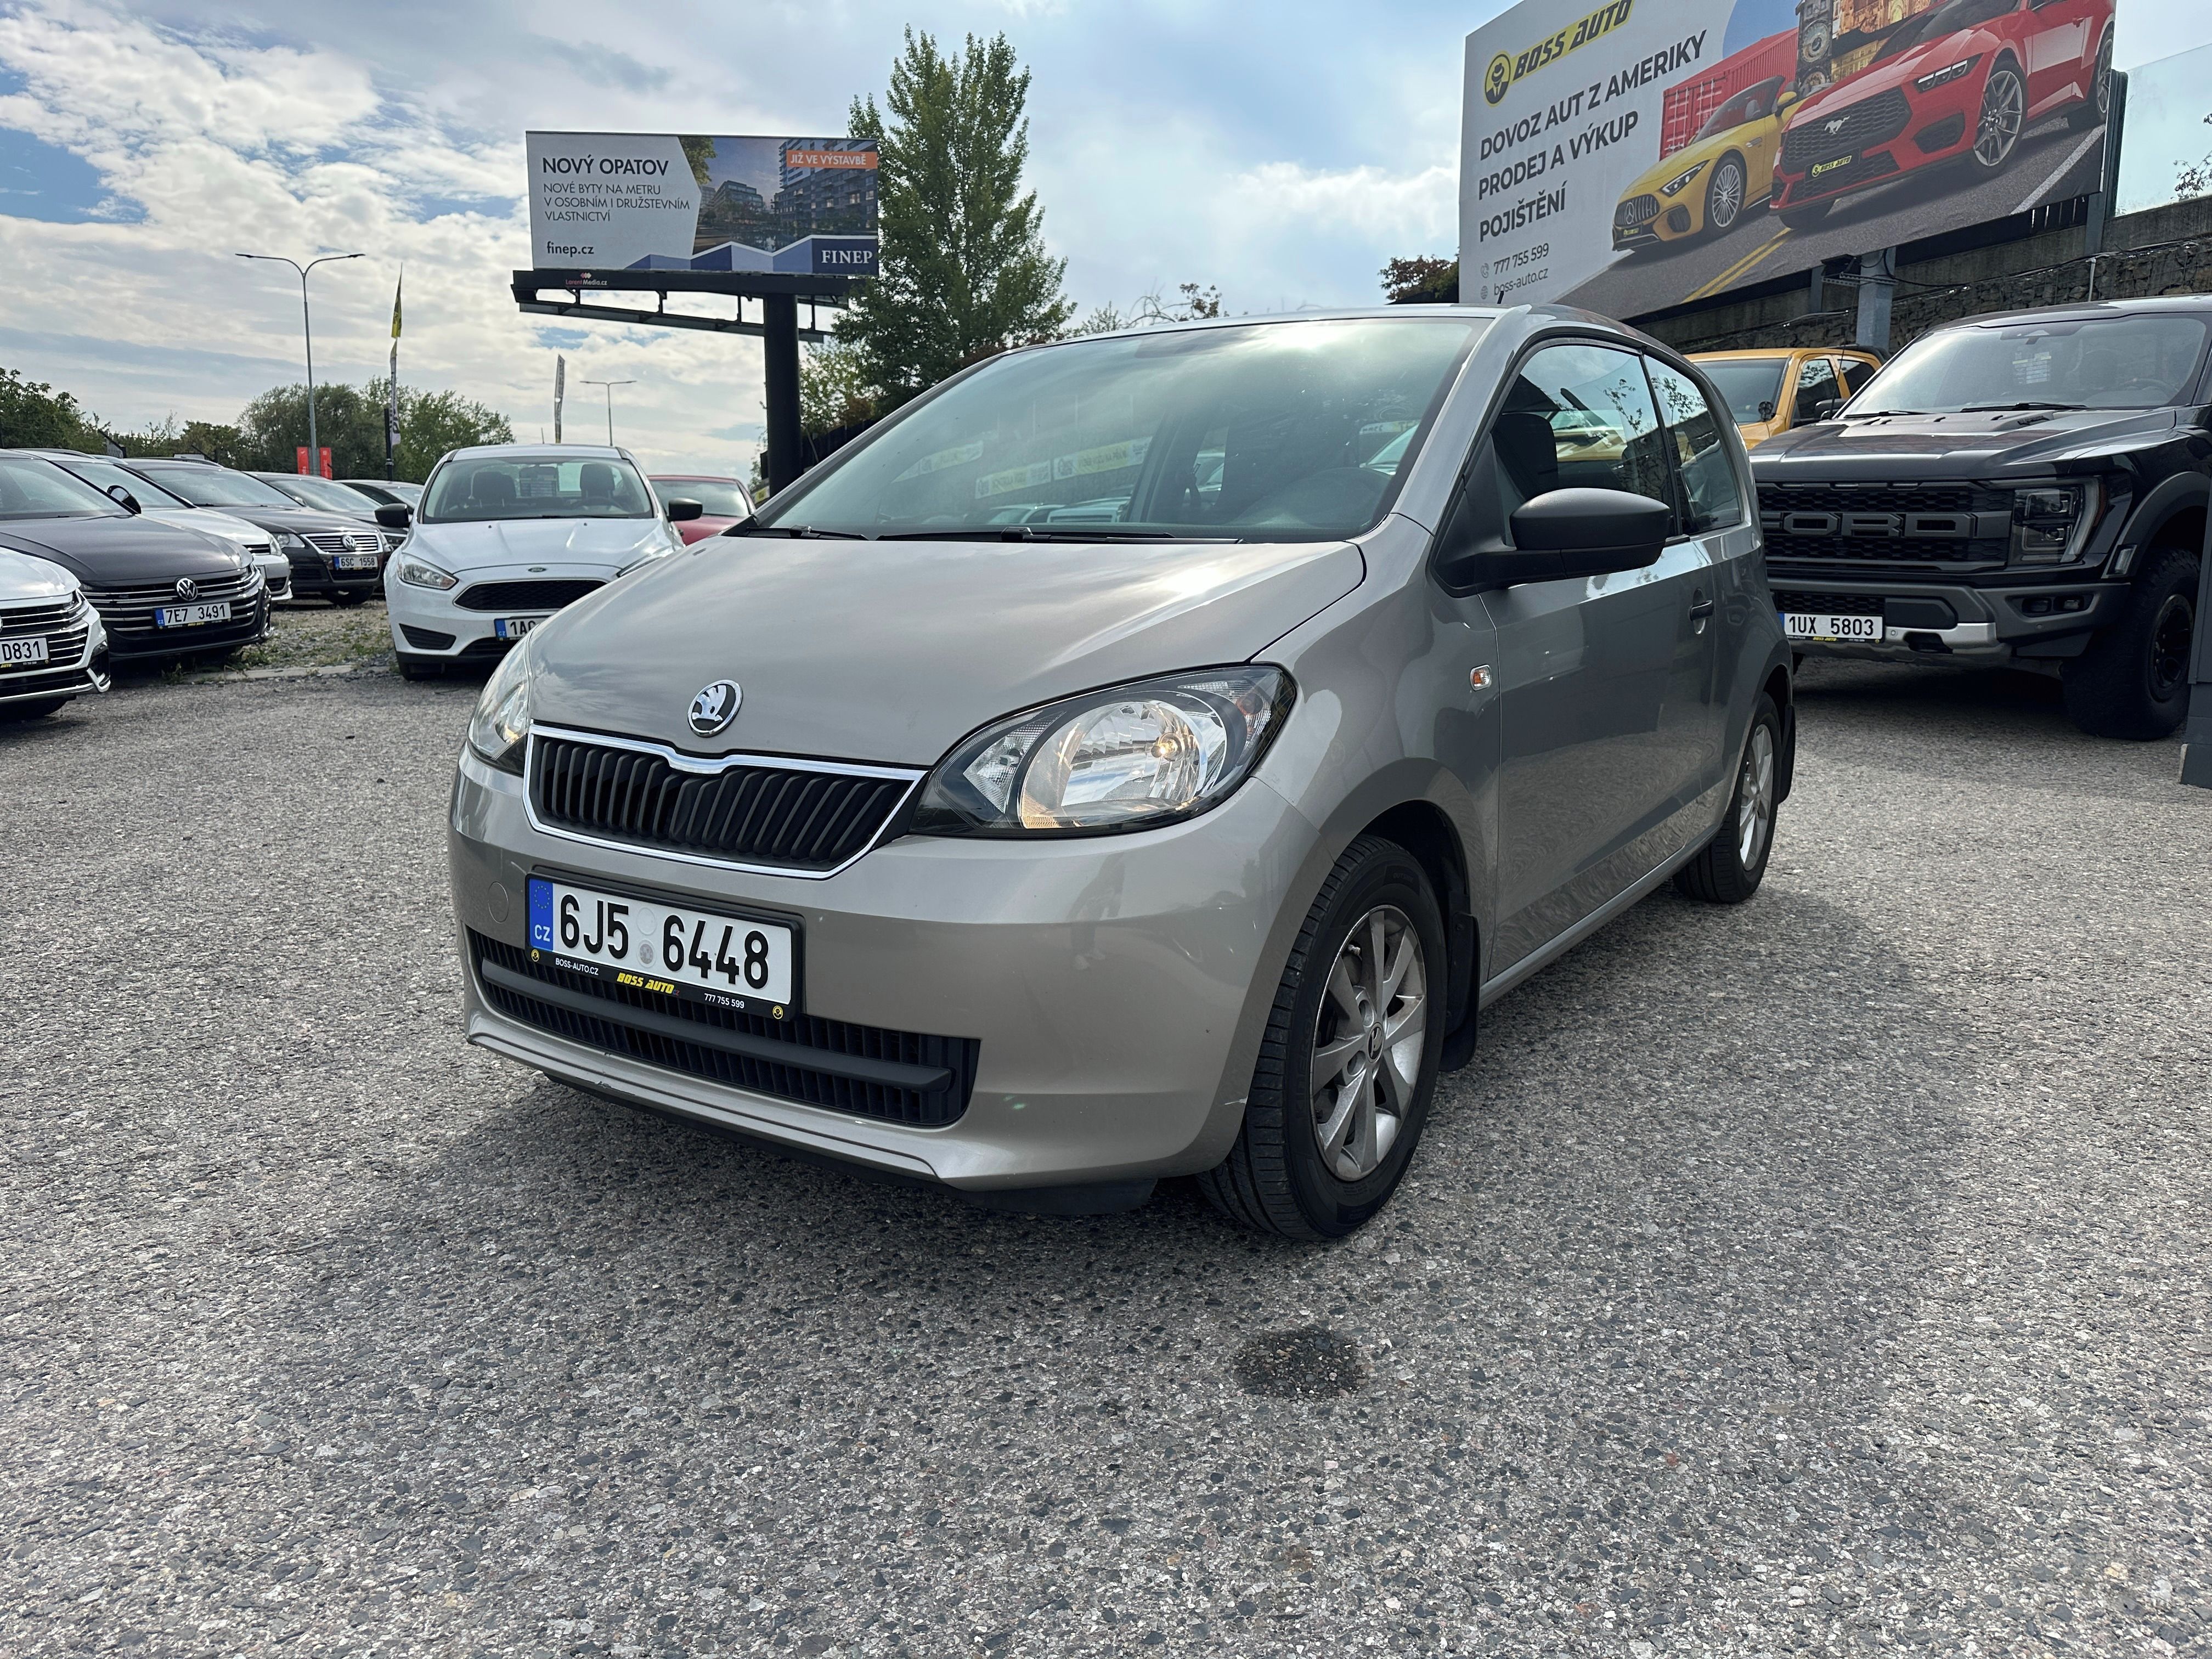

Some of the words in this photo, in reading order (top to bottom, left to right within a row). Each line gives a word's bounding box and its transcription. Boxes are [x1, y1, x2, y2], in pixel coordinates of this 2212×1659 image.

[1513, 31, 1566, 81] BOSS
[1569, 0, 1632, 50] AUTO
[1480, 112, 1542, 161] DOVOZ
[1545, 91, 1584, 131] AUT
[1588, 82, 1601, 110] Z
[1605, 30, 1707, 102] AMERIKY
[543, 154, 594, 174] NOVÝ
[599, 159, 669, 176] OPATOV
[791, 153, 803, 163] JIŽ
[806, 154, 817, 164] VE
[820, 153, 866, 165] VÝSTAVBĚ
[1479, 151, 1547, 200] PRODEJ
[1550, 144, 1565, 169] A
[1569, 111, 1638, 160] VÝKUP
[544, 181, 575, 194] NOVÉ
[578, 184, 602, 194] BYTY
[606, 184, 623, 194] NA
[626, 184, 661, 195] METRU
[544, 197, 551, 207] V
[555, 195, 607, 208] OSOBNÍM
[617, 196, 690, 210] DRUŽSTEVNÍM
[1480, 180, 1567, 242] POJIŠTĚNÍ
[545, 210, 610, 222] VLASTNICTVÍ
[547, 241, 594, 257] finep.cz
[821, 250, 873, 264] FINEP
[1494, 257, 1510, 274] 777
[1512, 250, 1528, 268] 755
[1531, 242, 1549, 261] 599
[1494, 268, 1549, 296] boss-auto.cz
[341, 558, 354, 566] 6SC
[359, 557, 375, 566] 1558
[166, 608, 188, 623] 7E7
[198, 605, 225, 619] 3491
[1789, 616, 1816, 634] 1UX
[1830, 618, 1874, 636] 5803
[2, 641, 41, 661] D831
[534, 924, 550, 942] CZ
[560, 894, 629, 960] 6J5
[663, 915, 769, 989] 6448
[555, 957, 599, 975] BOSS-AUTO.CZ
[617, 972, 644, 988] BOSS
[645, 979, 674, 995] AUTO
[704, 993, 716, 1003] 777
[717, 996, 730, 1006] 755
[731, 999, 744, 1009] 599
